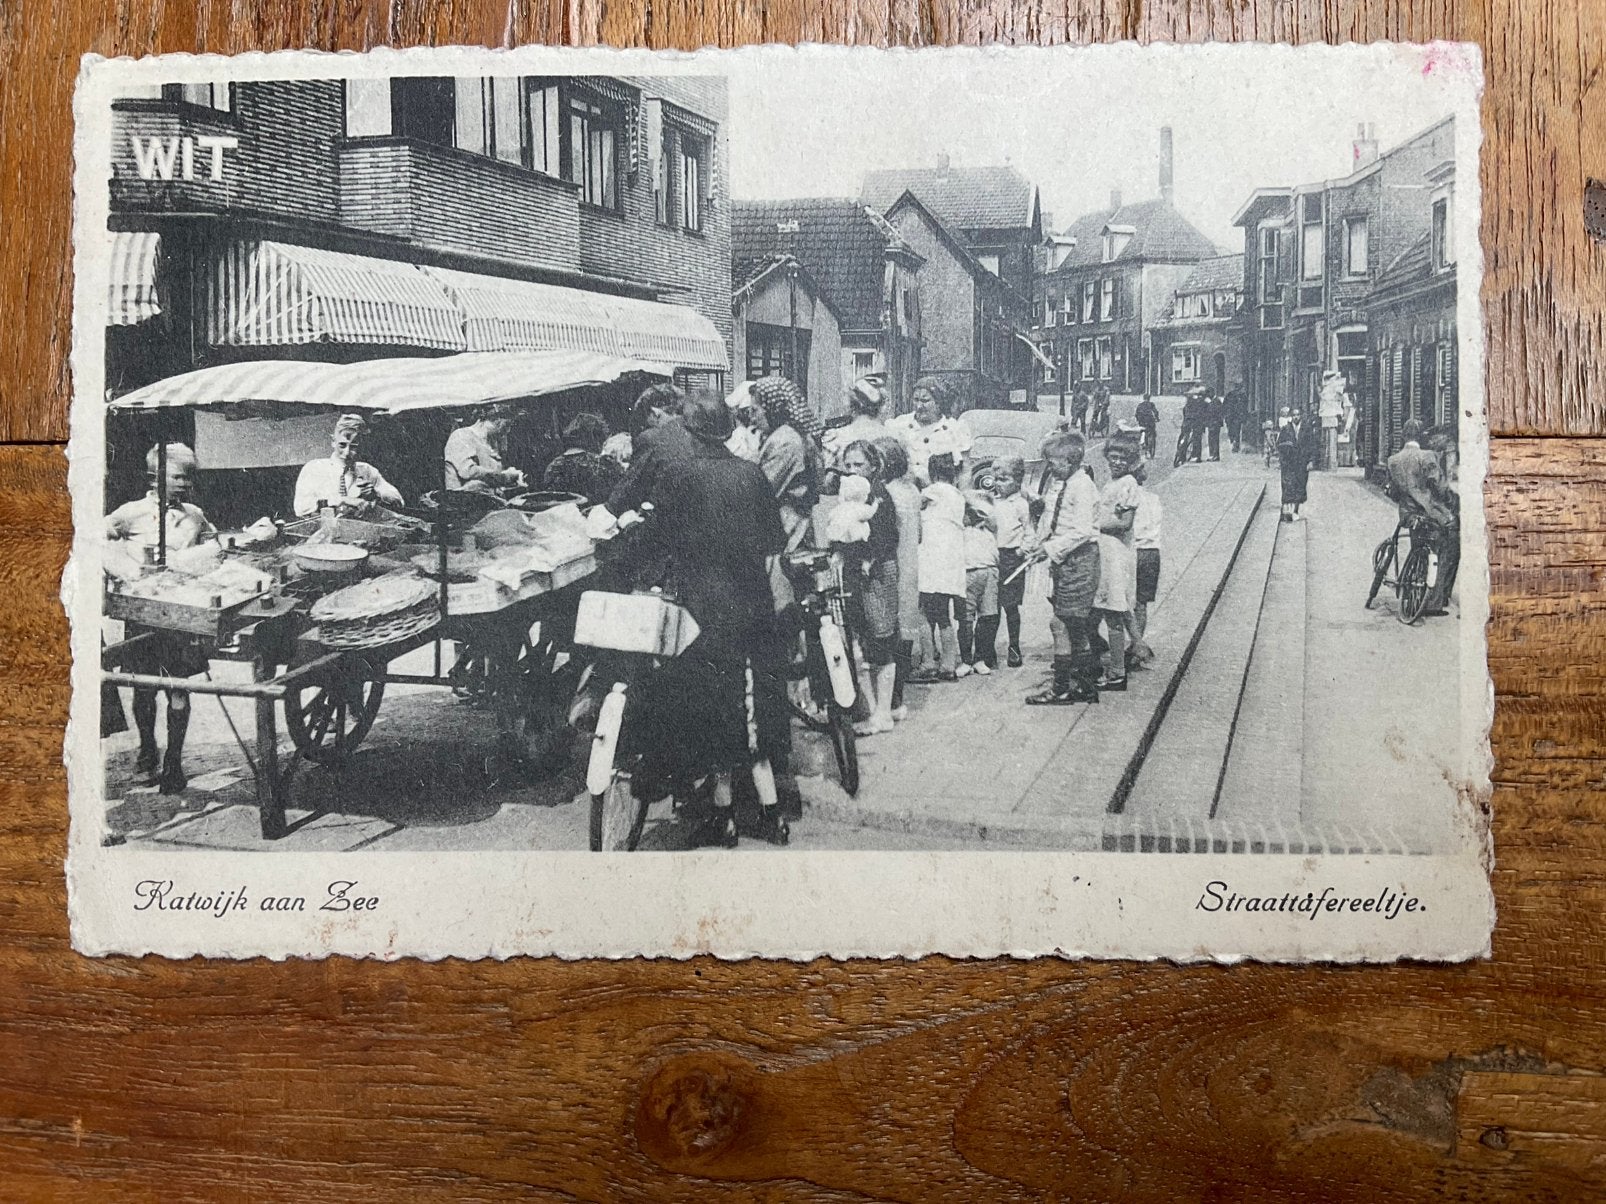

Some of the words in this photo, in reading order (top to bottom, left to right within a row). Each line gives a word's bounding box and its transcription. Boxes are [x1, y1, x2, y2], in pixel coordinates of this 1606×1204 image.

[132, 136, 239, 181] WIT
[133, 880, 248, 918] Katwijk
[259, 896, 306, 911] aan
[319, 880, 380, 912] Zee
[1195, 880, 1427, 920] Straattafereeltje.
